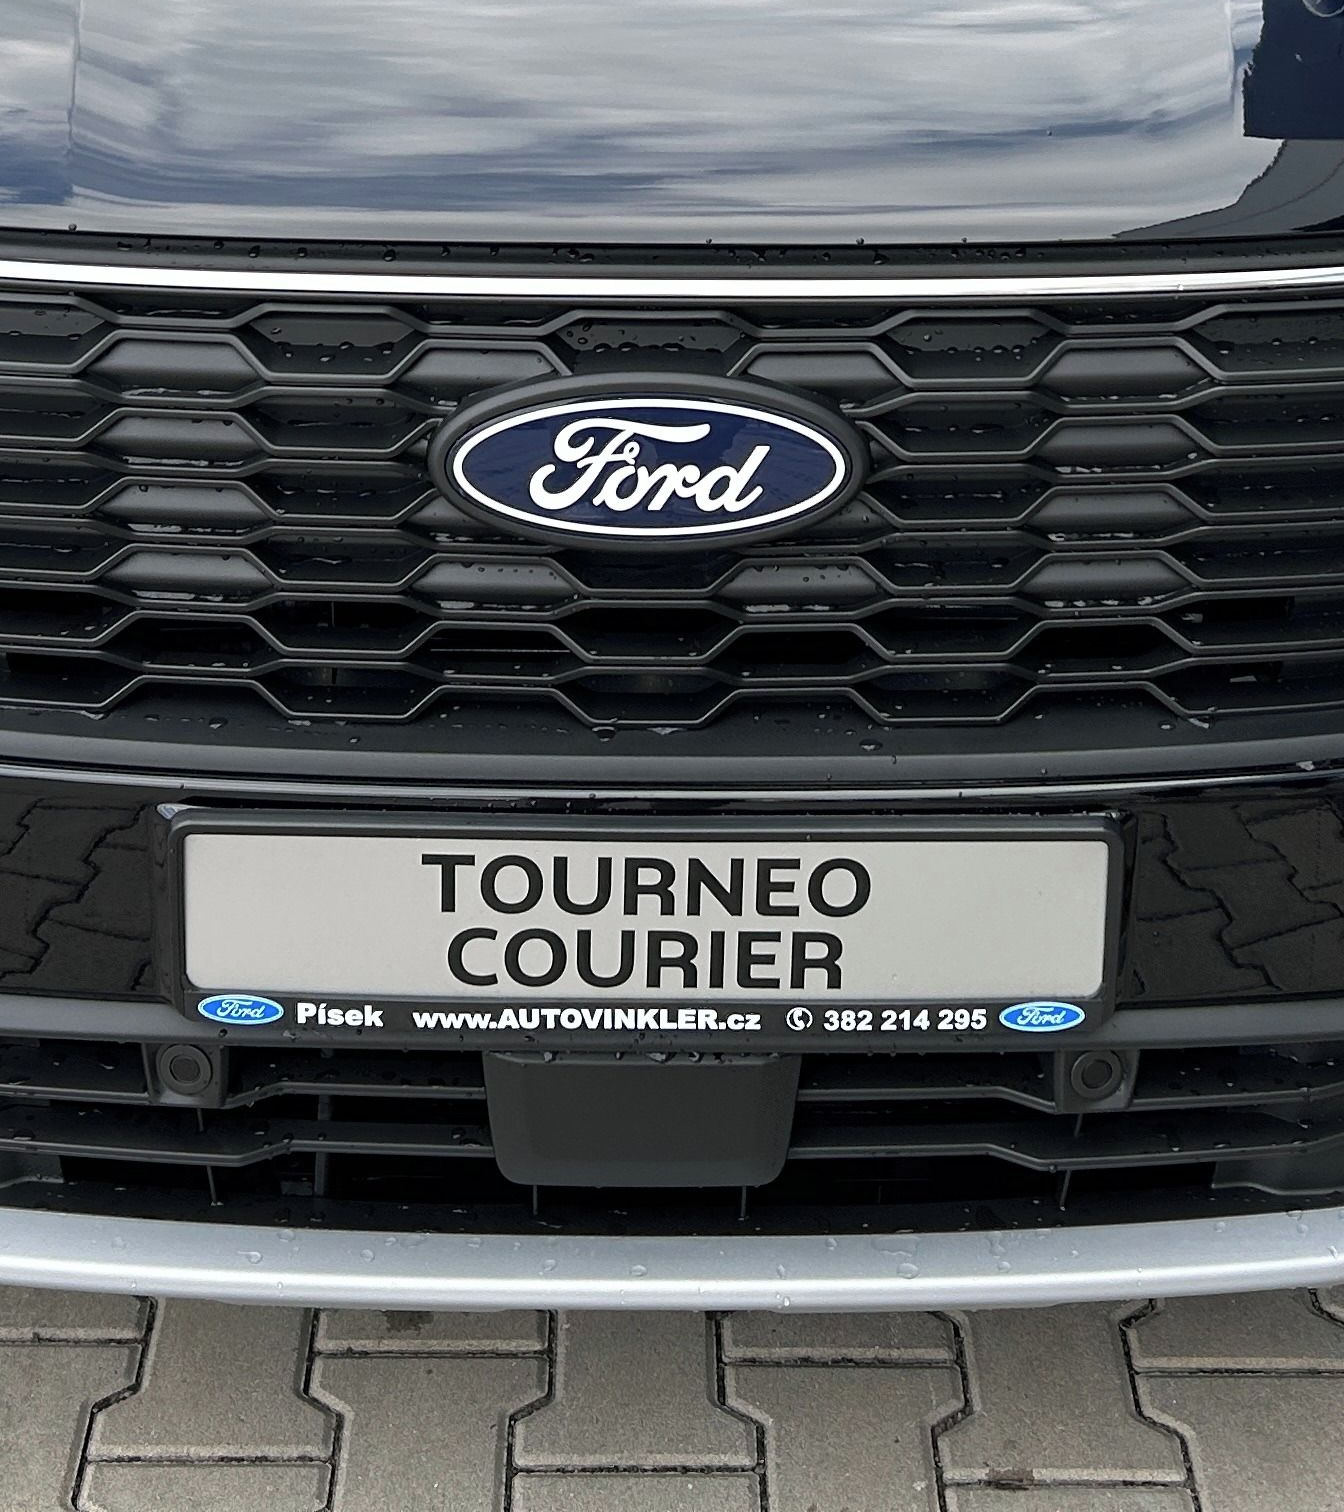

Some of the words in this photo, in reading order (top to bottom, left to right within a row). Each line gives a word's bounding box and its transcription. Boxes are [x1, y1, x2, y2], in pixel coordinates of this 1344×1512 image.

[529, 417, 770, 513] Ford
[421, 853, 871, 918] TOURNEO
[446, 927, 844, 990] COURIER
[297, 1002, 384, 1027] Písek
[412, 1008, 762, 1031] www.AUTOVINKLER.cz
[823, 1009, 873, 1031] 382
[880, 1009, 930, 1031] 214
[937, 1008, 987, 1030] 295
